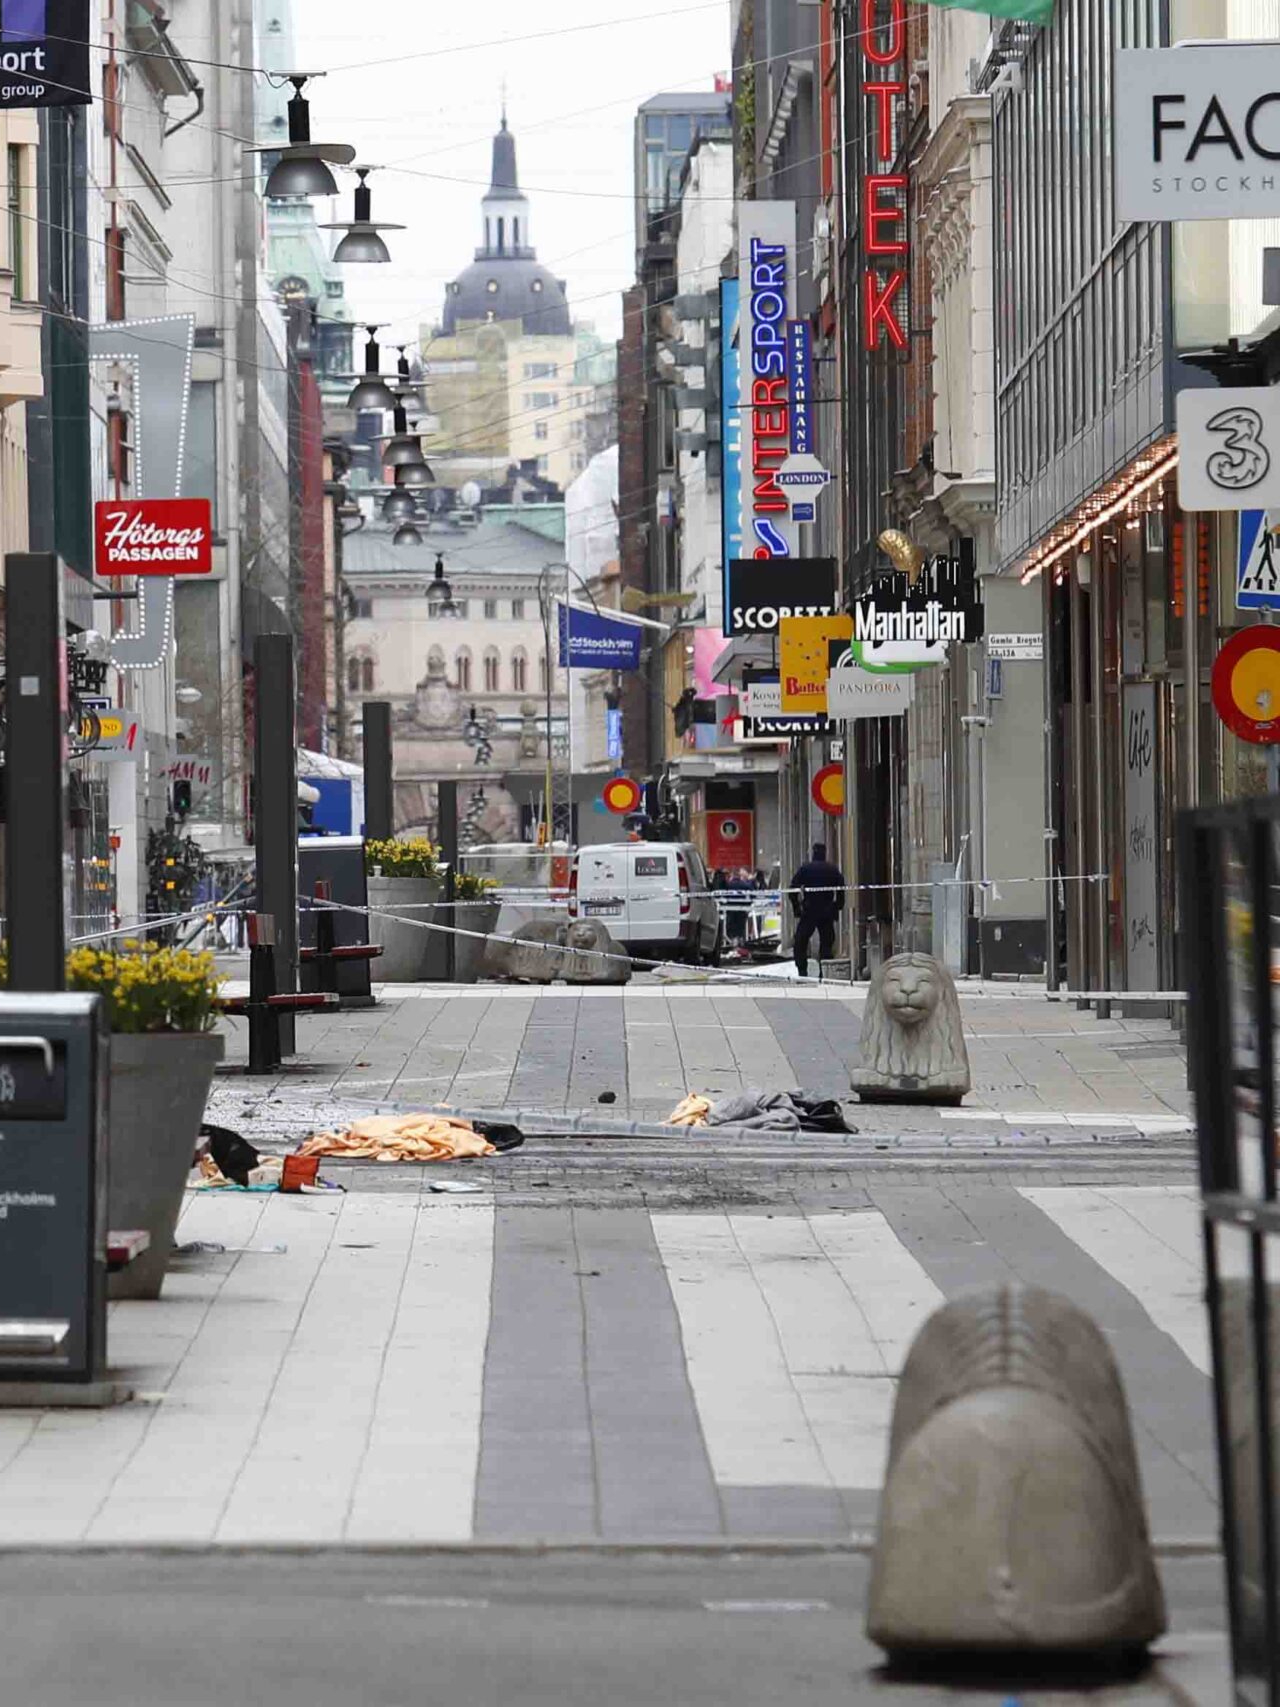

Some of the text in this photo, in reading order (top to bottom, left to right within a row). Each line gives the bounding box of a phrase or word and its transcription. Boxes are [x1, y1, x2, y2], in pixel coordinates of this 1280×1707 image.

[1, 84, 45, 99] group
[751, 238, 788, 512] INTERSPORT
[794, 324, 807, 453] RESTAURANG
[1205, 407, 1271, 491] 3
[779, 473, 826, 483] LONDON
[104, 510, 205, 549] Hötorgs
[108, 546, 199, 561] PASSAGEN
[855, 601, 965, 641] Manhattan
[839, 684, 901, 695] PANDORA
